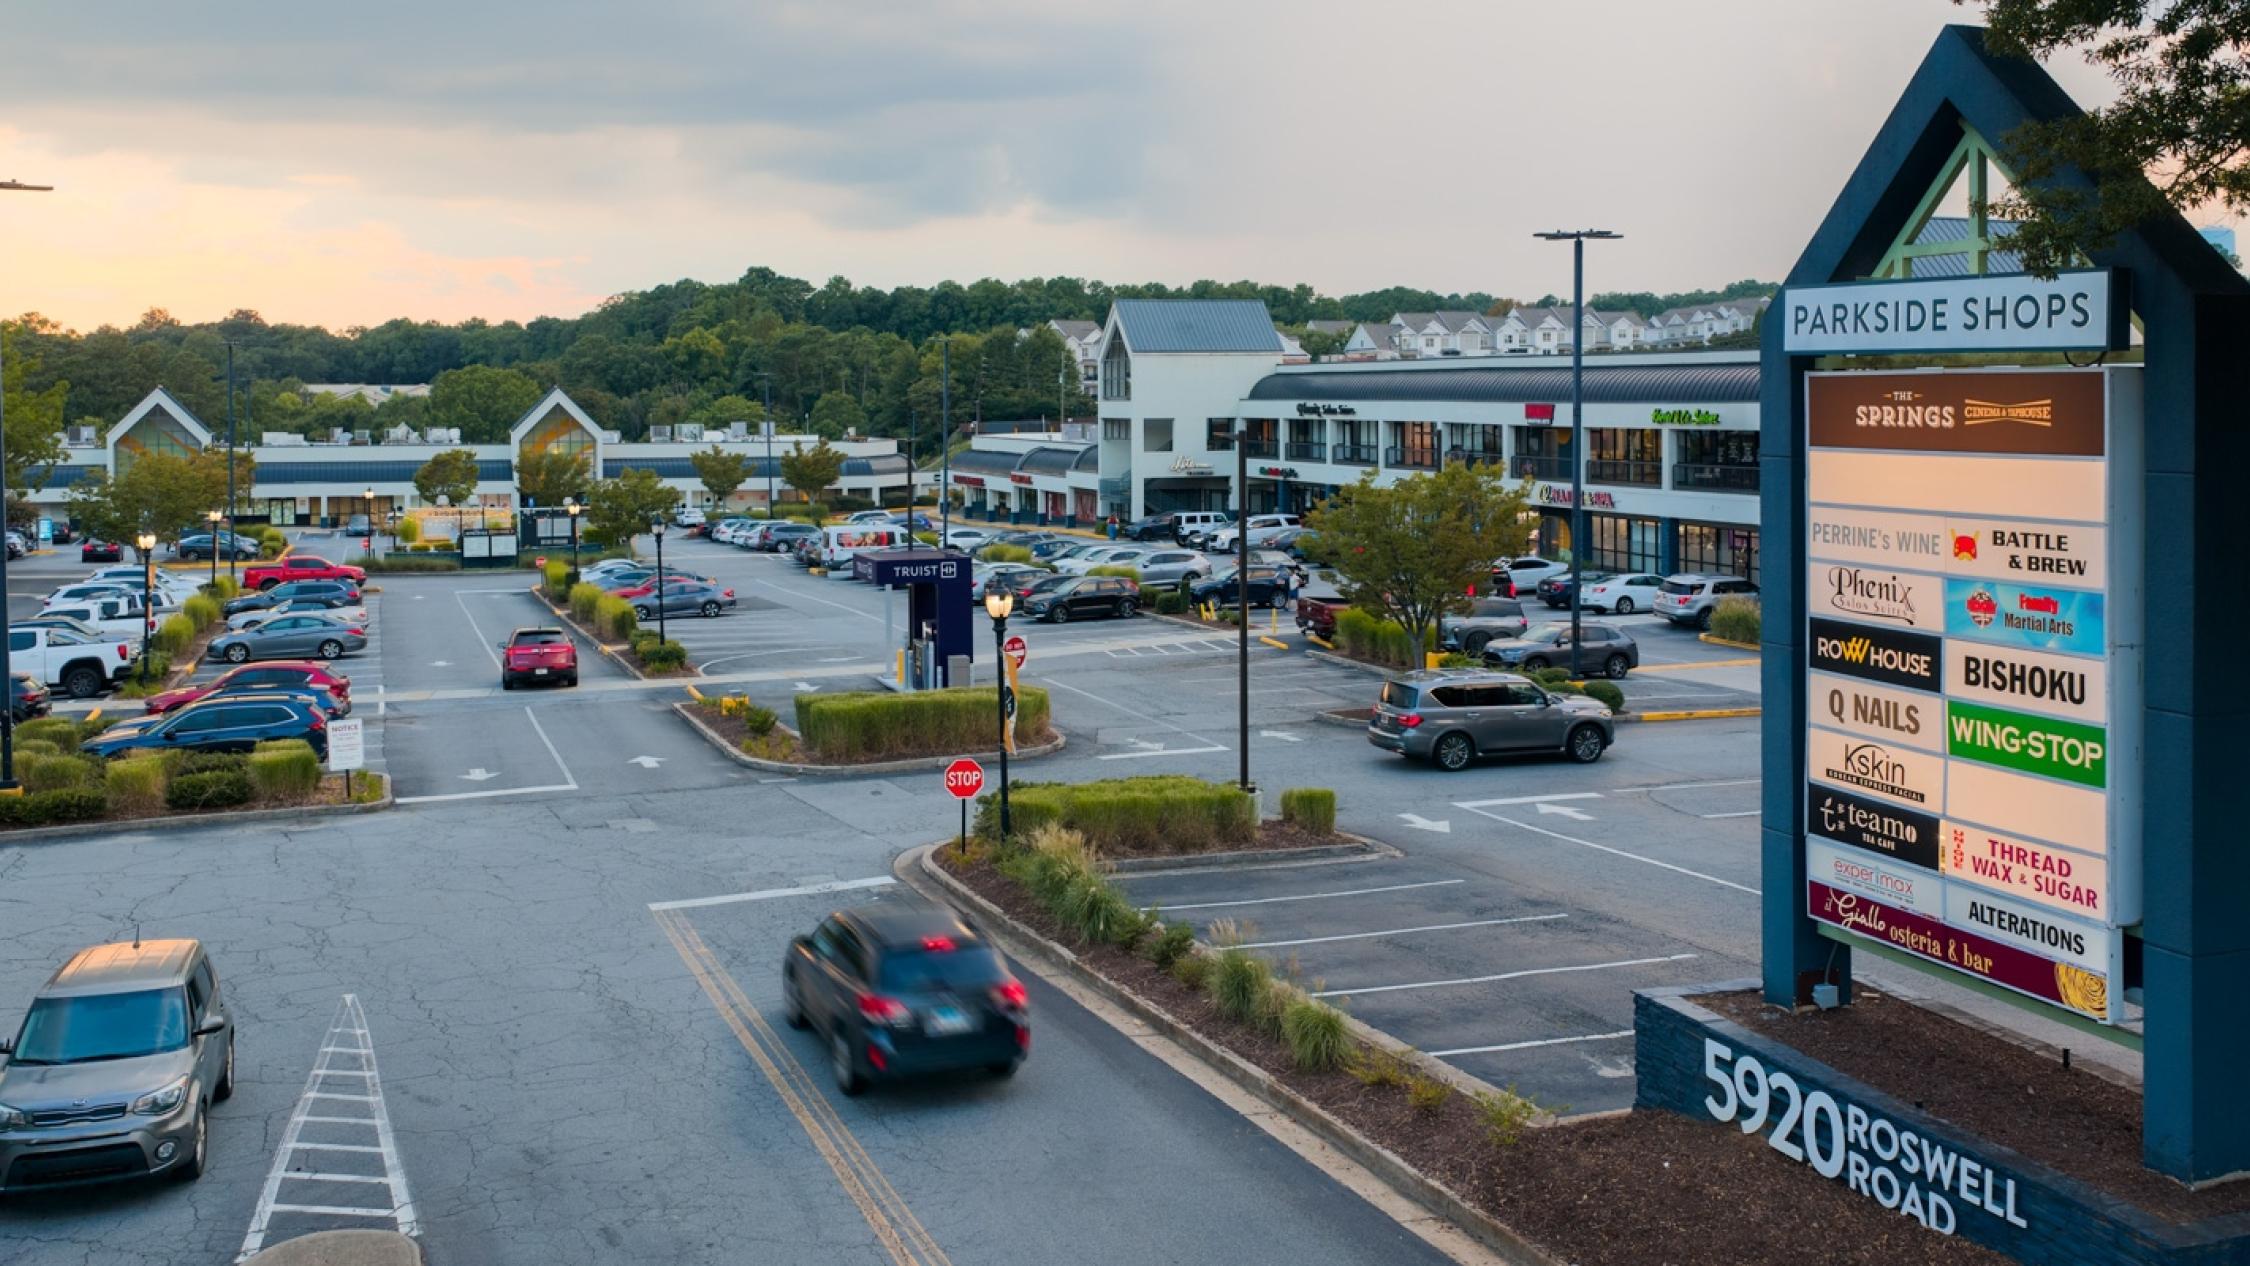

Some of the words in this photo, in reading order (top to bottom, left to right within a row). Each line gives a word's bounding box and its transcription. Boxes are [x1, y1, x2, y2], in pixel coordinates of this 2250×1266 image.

[1794, 298, 1949, 335] PARKSIDE
[1962, 292, 2091, 331] SHOPS
[1893, 391, 1913, 401] THE
[1964, 406, 2000, 418] CINEMA
[1855, 404, 1955, 429] SPRINGS
[1812, 522, 1890, 549] PERRINE's
[1896, 531, 1941, 555] WINE
[1991, 529, 2069, 552] BATTLE
[893, 564, 939, 578] TRUIST
[2008, 554, 2022, 570] &
[2027, 555, 2087, 576] BREW
[1828, 566, 1915, 612] Phenix
[2004, 612, 2046, 633] Martial
[2049, 618, 2074, 636] Arts
[1869, 647, 1932, 677] HOUSE
[1964, 655, 2086, 705] BISHOKU
[1828, 689, 1845, 723] Q
[1853, 693, 1921, 735] NAILS
[947, 771, 983, 787] STOP
[1844, 743, 1906, 786] Kskin
[1847, 803, 1918, 843] teamo
[1987, 838, 2073, 879] THREAD
[1971, 855, 2013, 884] WAX
[2018, 872, 2028, 885] &
[2034, 874, 2099, 910] SUGAR
[1829, 887, 1886, 931] Giallo
[1890, 925, 1942, 957] osteria
[1948, 938, 1959, 963] &
[1963, 942, 1993, 974] bar
[1968, 900, 2085, 956] ALTERATIONS
[1704, 1037, 1846, 1180] 5920
[1847, 1103, 2028, 1229] ROSWELL
[1848, 1150, 1956, 1236] ROAD
